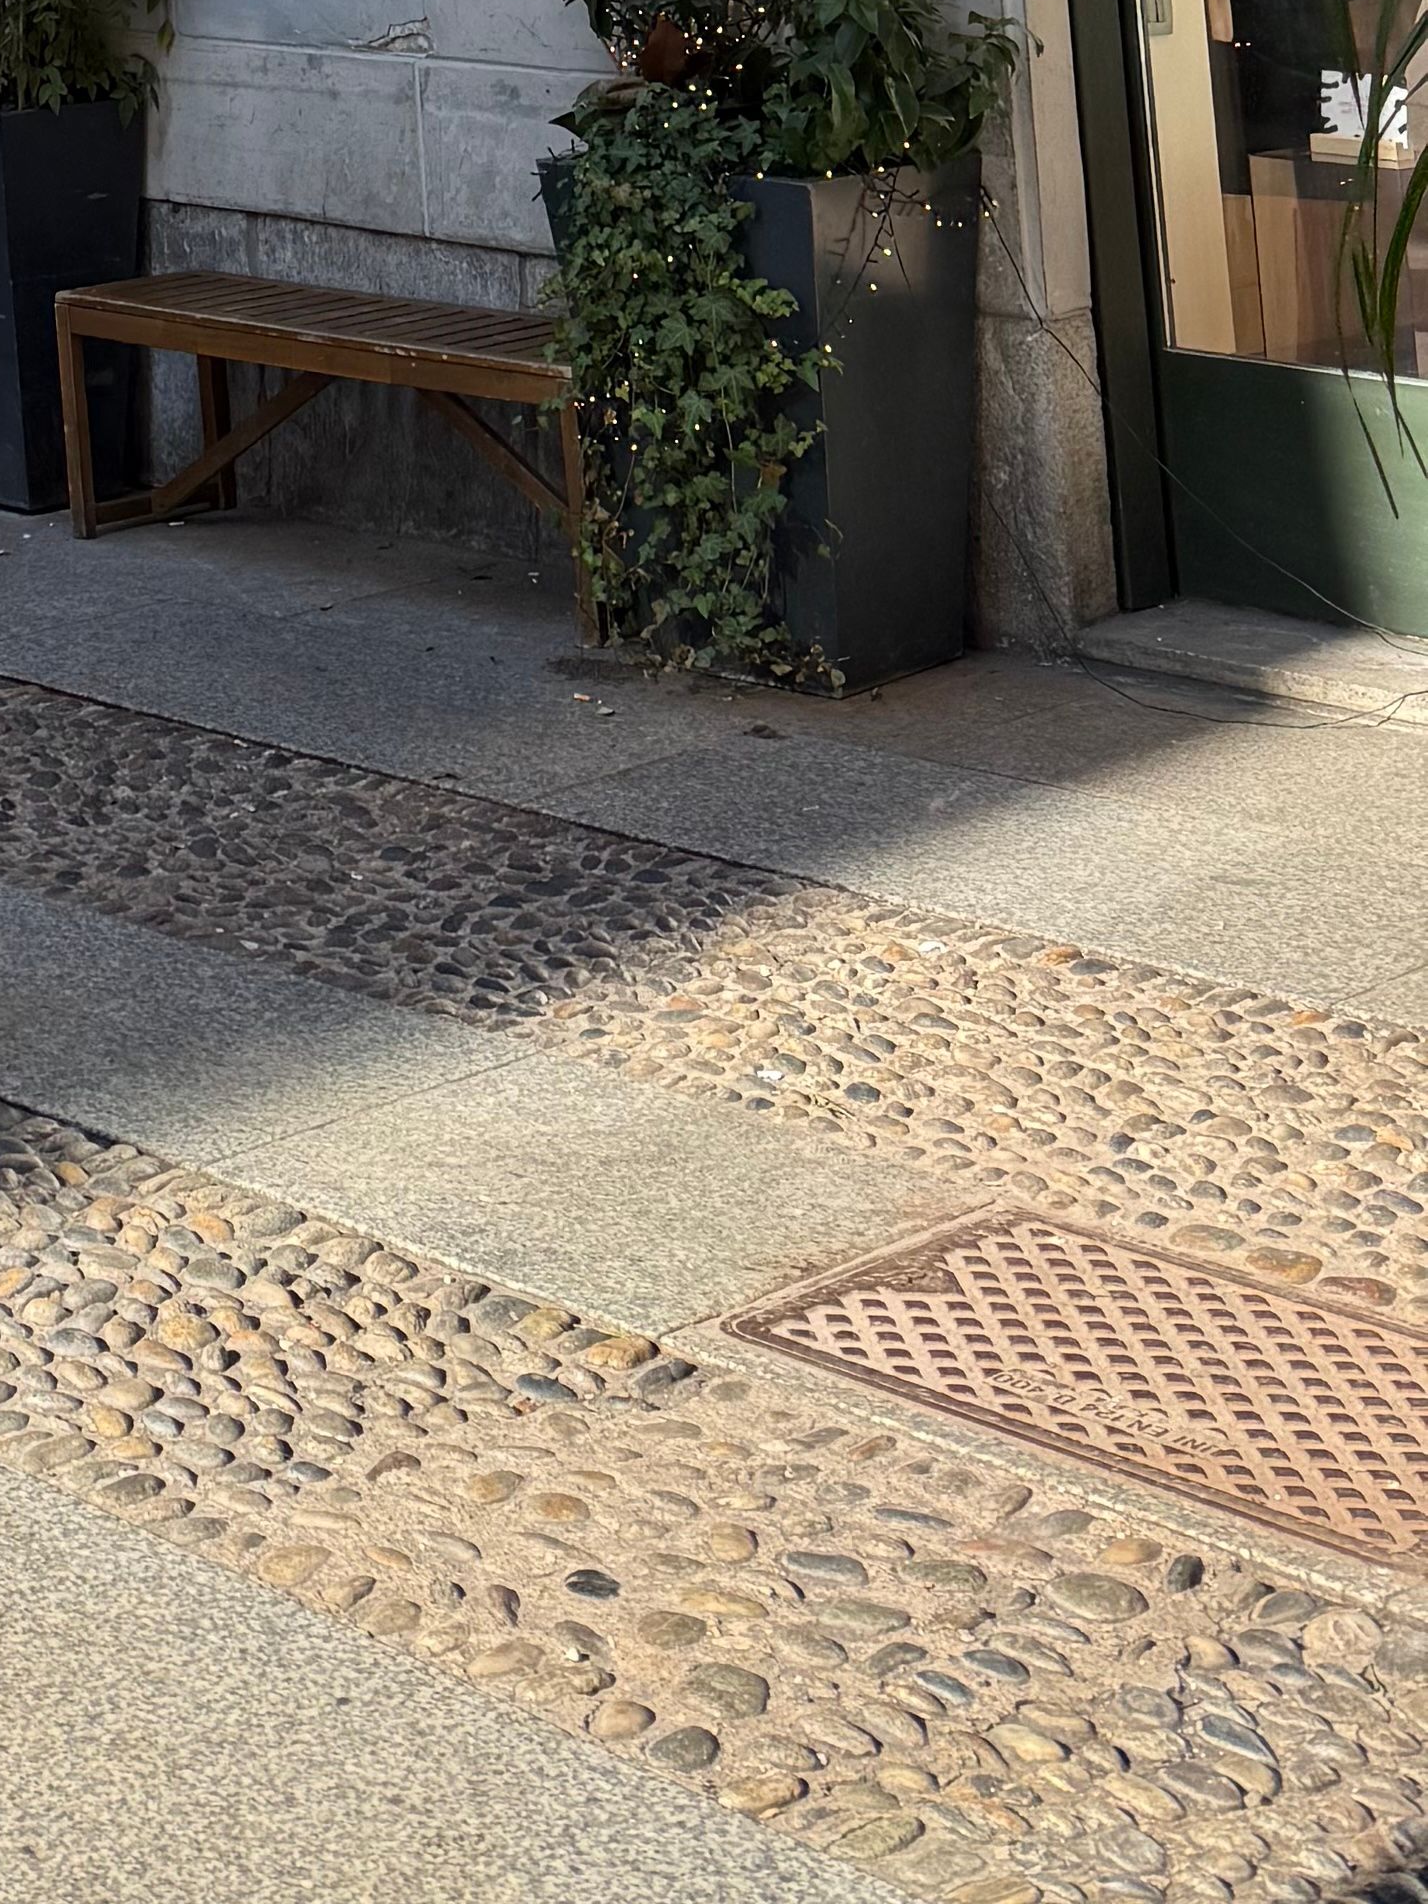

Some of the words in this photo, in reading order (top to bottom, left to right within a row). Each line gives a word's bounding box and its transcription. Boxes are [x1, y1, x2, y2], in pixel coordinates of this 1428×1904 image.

[992, 1373, 1045, 1393] 400
[1079, 1403, 1125, 1422] 124
[1126, 1419, 1170, 1438] EN
